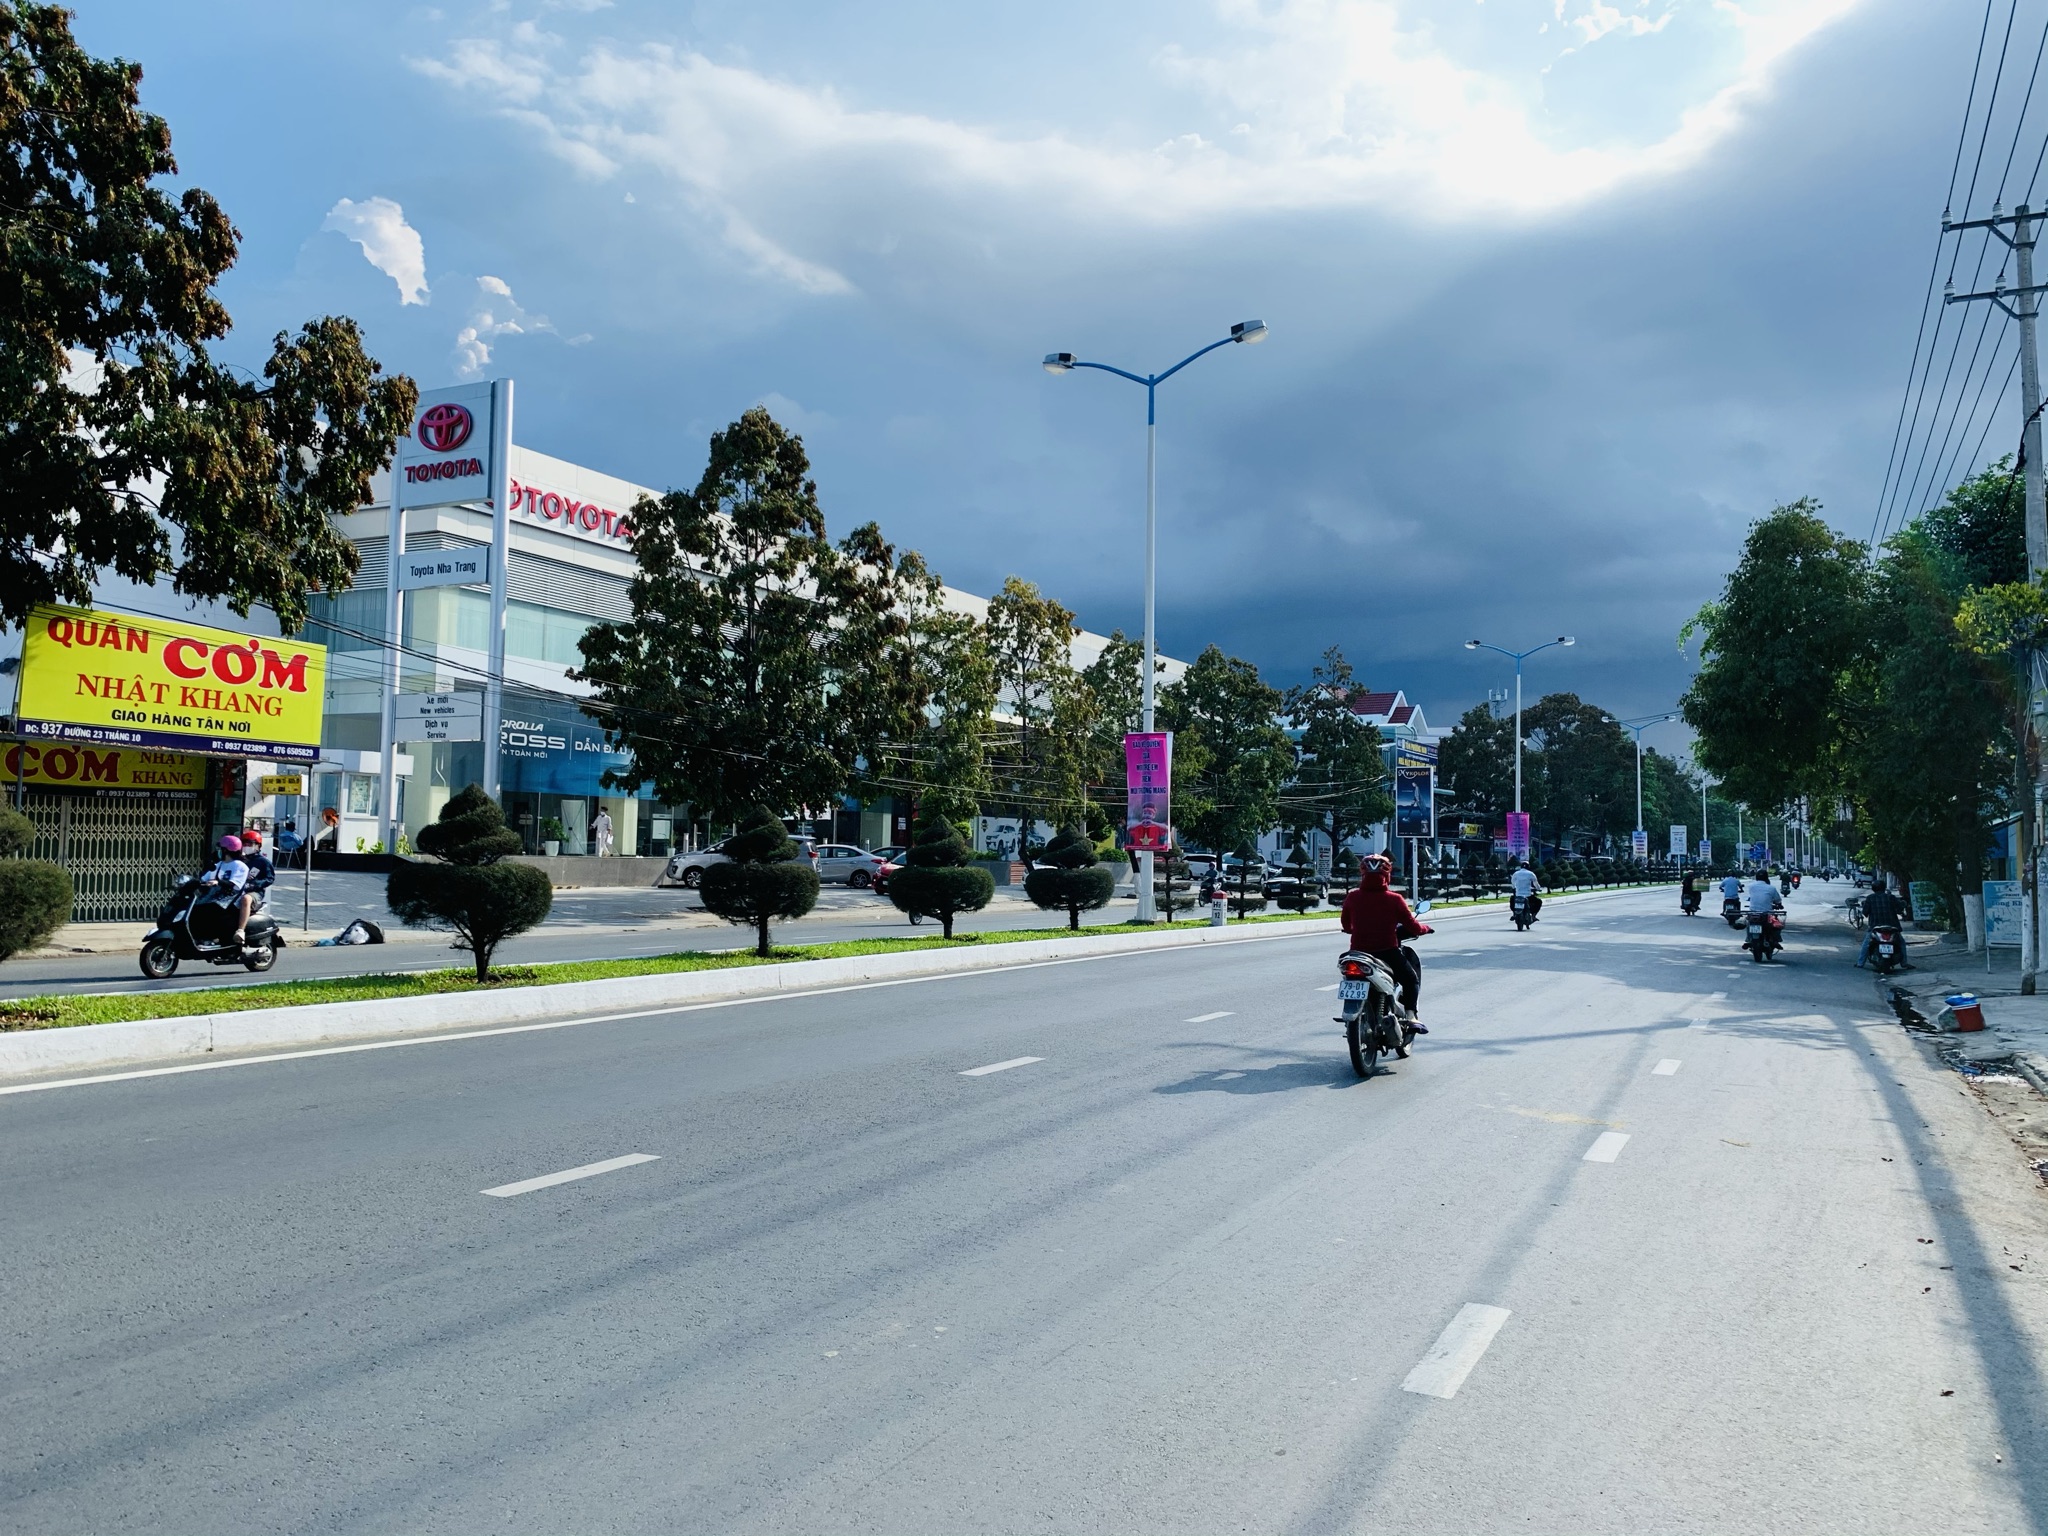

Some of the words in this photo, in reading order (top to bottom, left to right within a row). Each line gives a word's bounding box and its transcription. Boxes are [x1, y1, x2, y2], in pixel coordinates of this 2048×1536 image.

[405, 458, 482, 483] TOYOTA
[525, 485, 633, 538] TOYOTA
[410, 565, 434, 578] Toyota
[437, 563, 452, 574] Nha
[455, 561, 476, 574] Trang
[48, 615, 149, 654] QUÁN
[163, 638, 309, 693] CƠM
[76, 674, 170, 707] NHẬT
[179, 686, 283, 717] KHANG
[434, 706, 455, 714] vehicles
[111, 709, 147, 723] GIAO
[152, 711, 192, 728] HÀNG
[196, 715, 224, 732] TẬN
[228, 720, 251, 733] NƠI
[425, 719, 438, 730] Dịch
[502, 719, 544, 732] OROLLA
[41, 723, 63, 736] 937
[93, 730, 103, 739] 23
[105, 730, 130, 741] THÁNG
[131, 733, 141, 742] 10
[427, 731, 446, 739] Service
[225, 742, 241, 751] 0937
[243, 743, 267, 753] 023899
[273, 746, 285, 754] 076
[575, 737, 601, 752] DẪN
[510, 749, 531, 757] TOÀN
[5, 744, 121, 783] CƠM
[132, 770, 193, 785] KHANG
